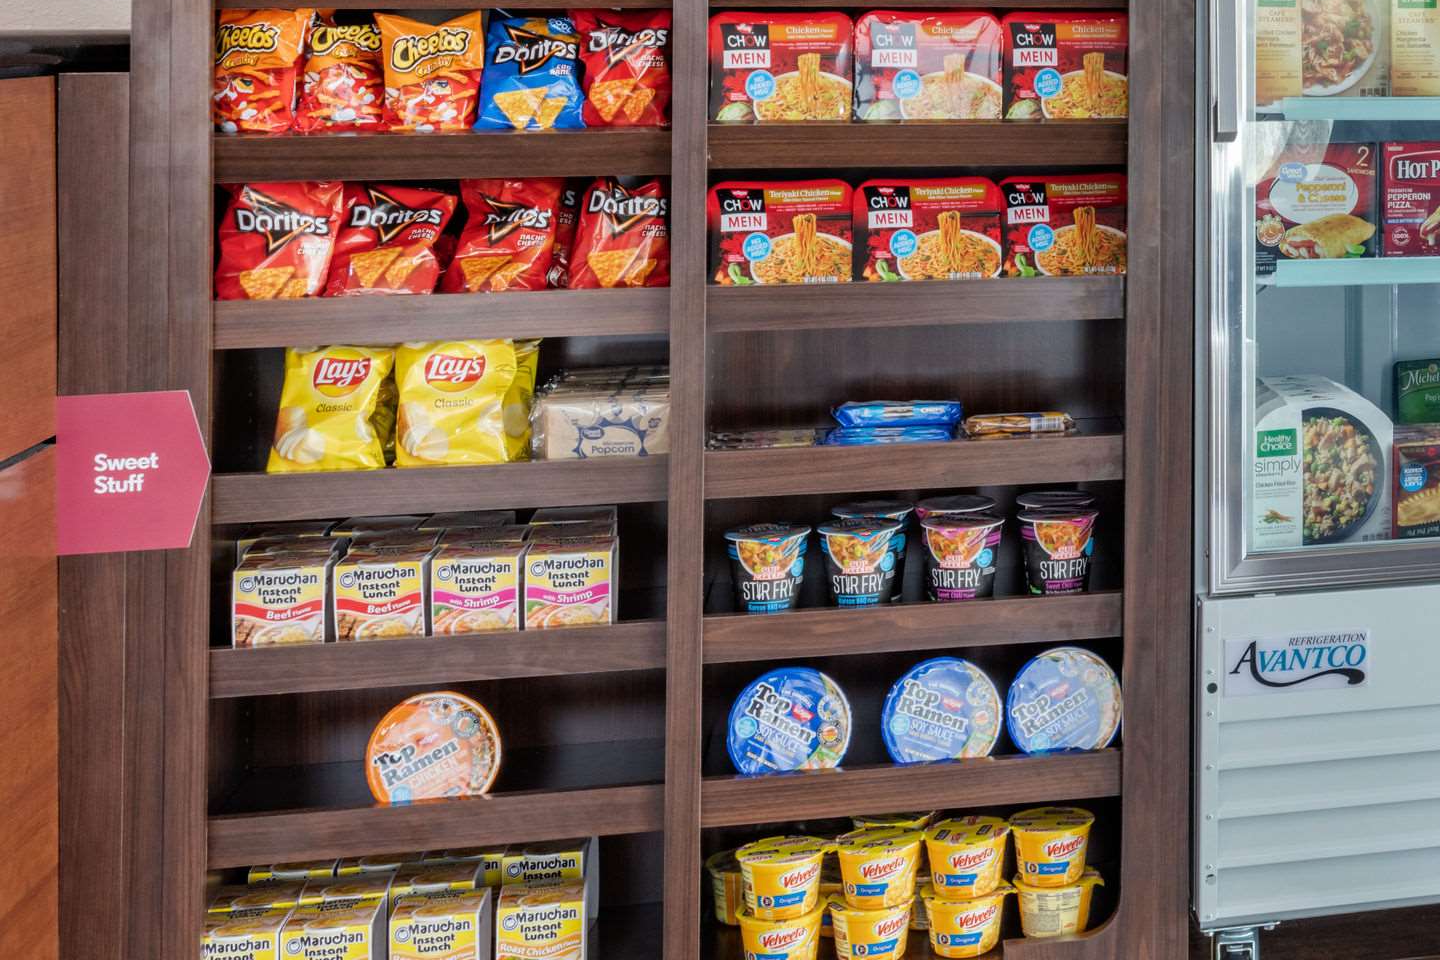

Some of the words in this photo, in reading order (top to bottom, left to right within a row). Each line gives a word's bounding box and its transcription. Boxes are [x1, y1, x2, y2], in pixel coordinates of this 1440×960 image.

[590, 28, 668, 51] Doritos
[727, 34, 767, 48] CHOW
[1016, 33, 1054, 47] CHOW
[393, 27, 470, 71] Cheetos
[495, 40, 577, 64] Doritos
[731, 51, 766, 65] MEIN
[879, 50, 913, 64] MEIN
[1020, 50, 1053, 63] MEIN
[1355, 145, 1369, 167] 2
[1396, 159, 1429, 179] HOT
[589, 190, 668, 216] Doritos
[871, 195, 908, 209] CHOW
[1008, 192, 1045, 205] CHOW
[1387, 192, 1431, 201] PEPPERONI
[724, 198, 763, 212] CHOW
[1387, 201, 1411, 209] PIZZA
[236, 208, 330, 234] Doritos
[351, 205, 443, 228] Doritos
[728, 215, 763, 228] MEIN
[875, 213, 909, 225] MEIN
[1014, 208, 1046, 221] MEIN
[316, 356, 372, 388] Lay's
[428, 353, 487, 385] Lay's
[315, 401, 353, 413] Classic
[434, 397, 475, 409] Classic
[1264, 434, 1292, 443] Healthy
[591, 444, 636, 456] Popcorn
[1260, 442, 1293, 452] Choice
[93, 452, 159, 472] Sweet
[1254, 456, 1301, 476] simply
[93, 474, 145, 495] Stuff
[450, 562, 512, 575] Maruchan
[543, 557, 604, 570] Maruchan
[1040, 560, 1067, 580] STIR
[1069, 558, 1089, 578] FRY
[253, 573, 318, 587] Maruchan
[353, 567, 416, 581] Maruchan
[454, 575, 497, 585] Instant
[548, 570, 590, 580] Instant
[931, 569, 955, 588] STIR
[957, 568, 981, 588] FRY
[358, 581, 401, 591] Instant
[459, 583, 492, 593] Lunch
[552, 579, 585, 589] Lunch
[742, 581, 770, 601] STIR
[772, 578, 796, 599] FRY
[832, 575, 859, 594] STIR
[861, 573, 885, 593] FRY
[258, 587, 302, 596] Instant
[363, 590, 396, 599] Lunch
[556, 590, 594, 604] Shrimp
[262, 595, 297, 605] Lunch
[464, 595, 500, 609] Shrimp
[266, 609, 292, 621] Beef
[367, 603, 392, 614] Beef
[1288, 631, 1368, 648] REFRIGERATION
[1228, 640, 1368, 687] AVANTCO
[756, 682, 792, 714] Top
[905, 679, 940, 705] Top
[899, 696, 968, 731] Ramen
[1013, 696, 1049, 722] Top
[1022, 689, 1088, 737] Ramen
[747, 698, 816, 743] Ramen
[910, 718, 928, 729] SOY
[928, 722, 956, 739] SAUCE
[374, 744, 416, 769] Top
[382, 739, 460, 788] Ramen
[519, 857, 576, 871] Maruchan
[951, 847, 994, 869] Velveeta
[862, 857, 905, 879] Velveeta
[523, 870, 562, 881] Instant
[516, 908, 577, 923] Maruchan
[959, 904, 997, 929] Velveeta
[409, 919, 471, 934] Maruchan
[520, 922, 562, 933] Instant
[300, 932, 364, 947] Maruchan
[413, 933, 455, 945] Instant
[524, 931, 558, 941] Lunch
[762, 927, 806, 948] Velveeta
[205, 939, 270, 954] Maruchan
[305, 946, 348, 957] Instant
[417, 943, 451, 953] Lunch
